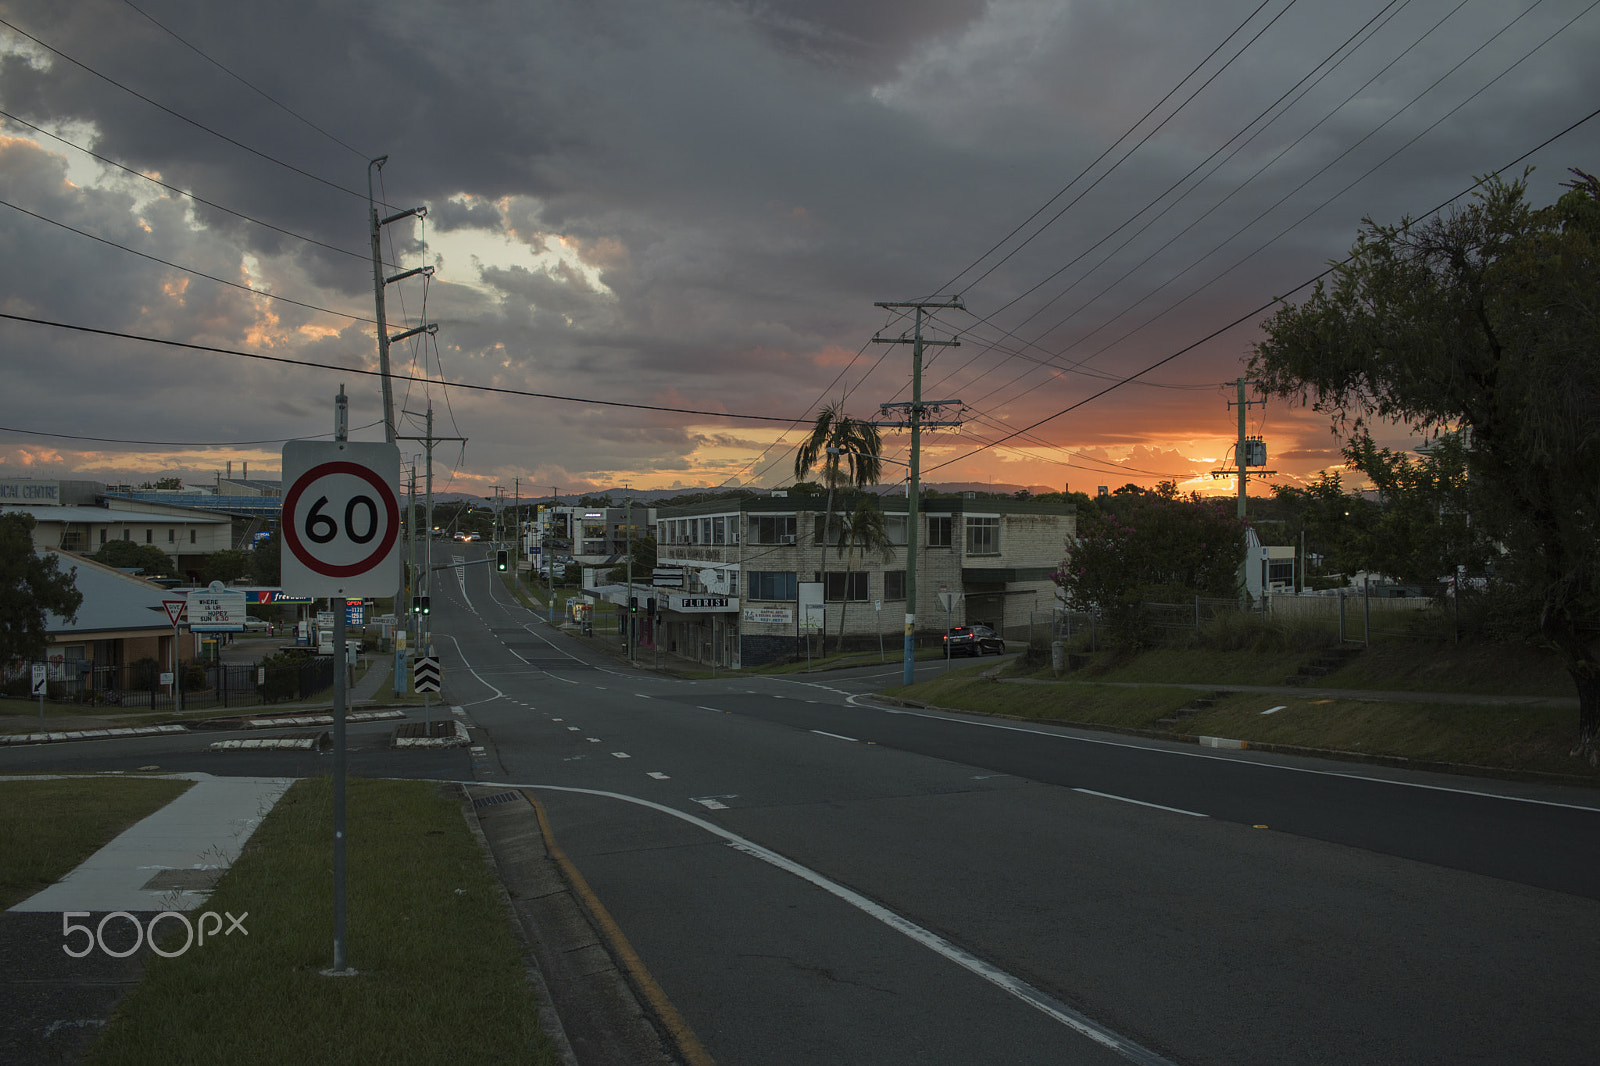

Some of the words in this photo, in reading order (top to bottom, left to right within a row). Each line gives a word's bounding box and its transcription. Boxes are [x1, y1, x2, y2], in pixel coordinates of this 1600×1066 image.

[23, 485, 58, 499] CENTRE
[305, 495, 378, 544] 60
[683, 599, 727, 607] FLORIST
